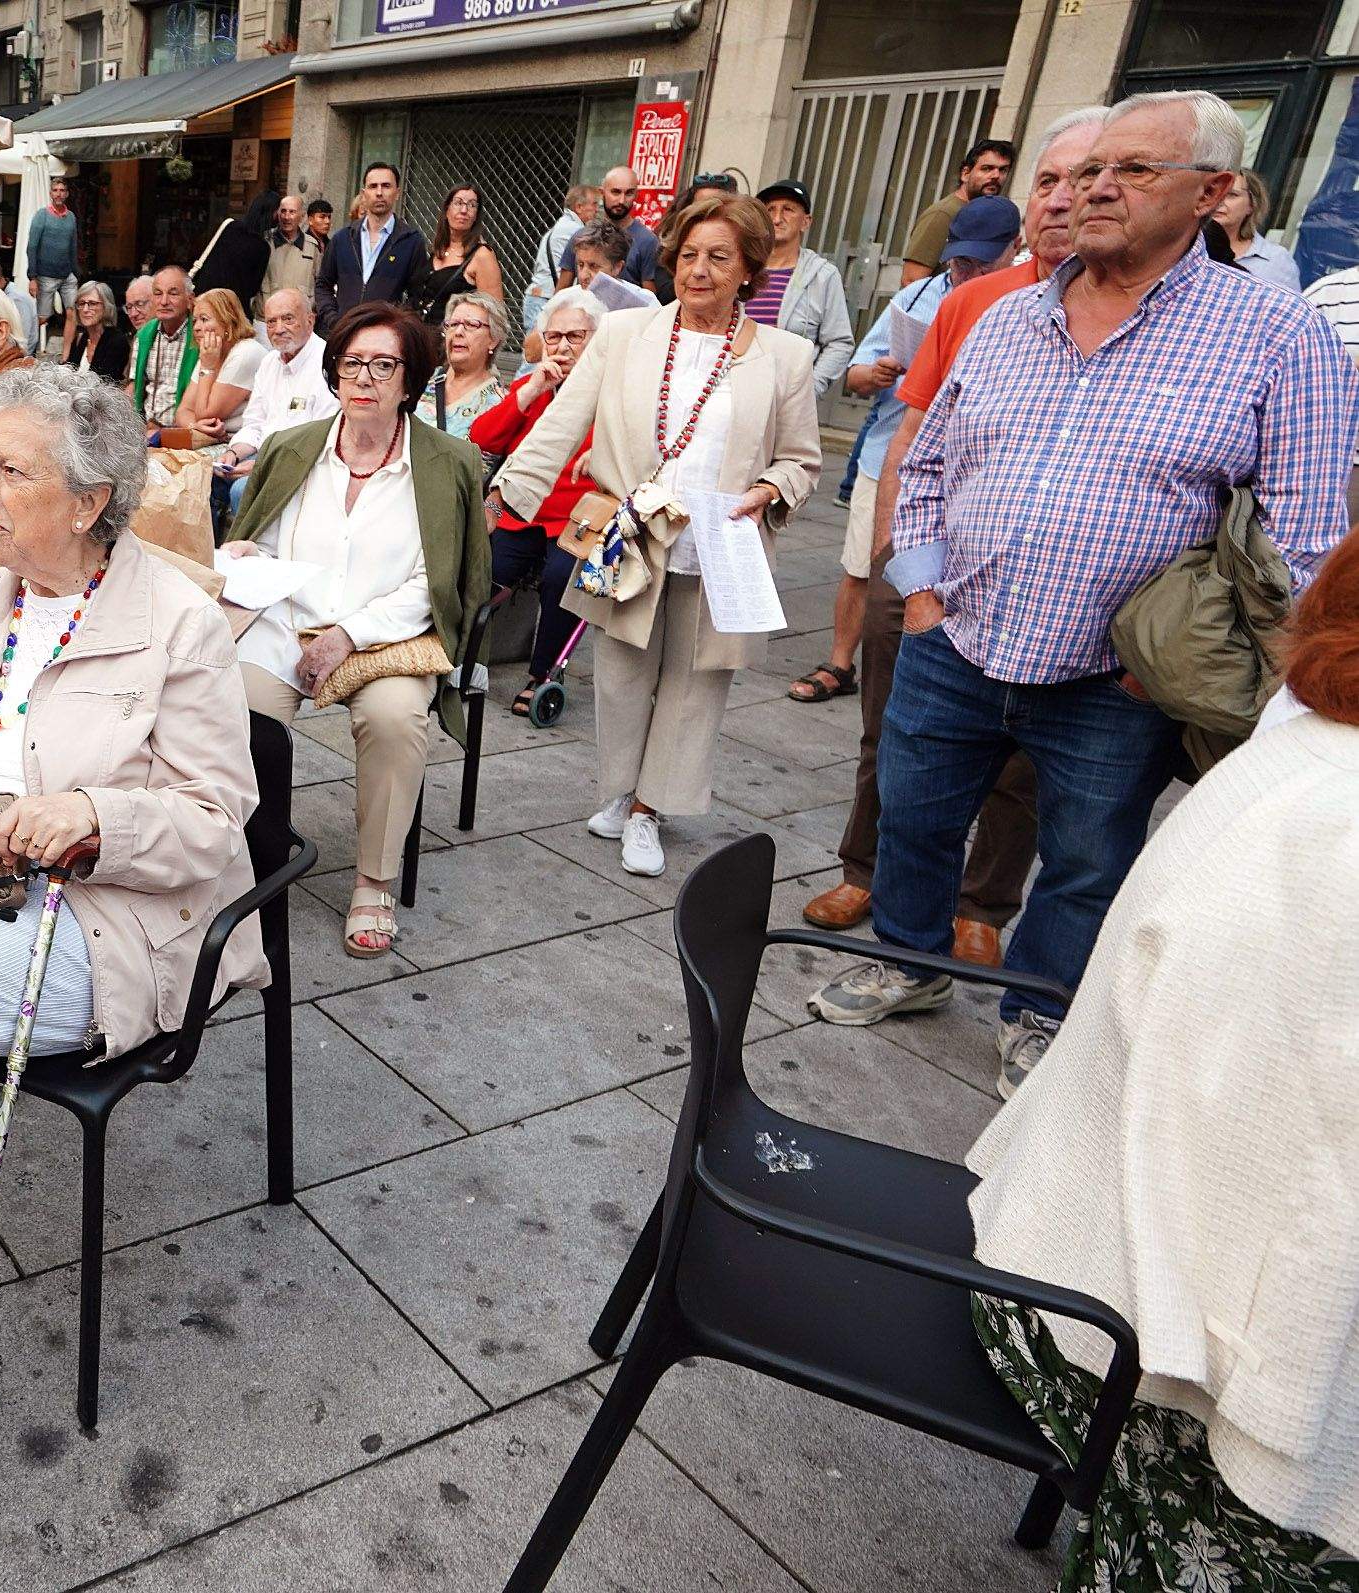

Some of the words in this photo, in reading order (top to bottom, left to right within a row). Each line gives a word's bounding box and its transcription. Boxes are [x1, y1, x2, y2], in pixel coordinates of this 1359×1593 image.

[1065, 1, 1080, 13] 12
[630, 61, 643, 76] 14
[637, 133, 679, 156] ESPACIO
[633, 156, 672, 186] MODA
